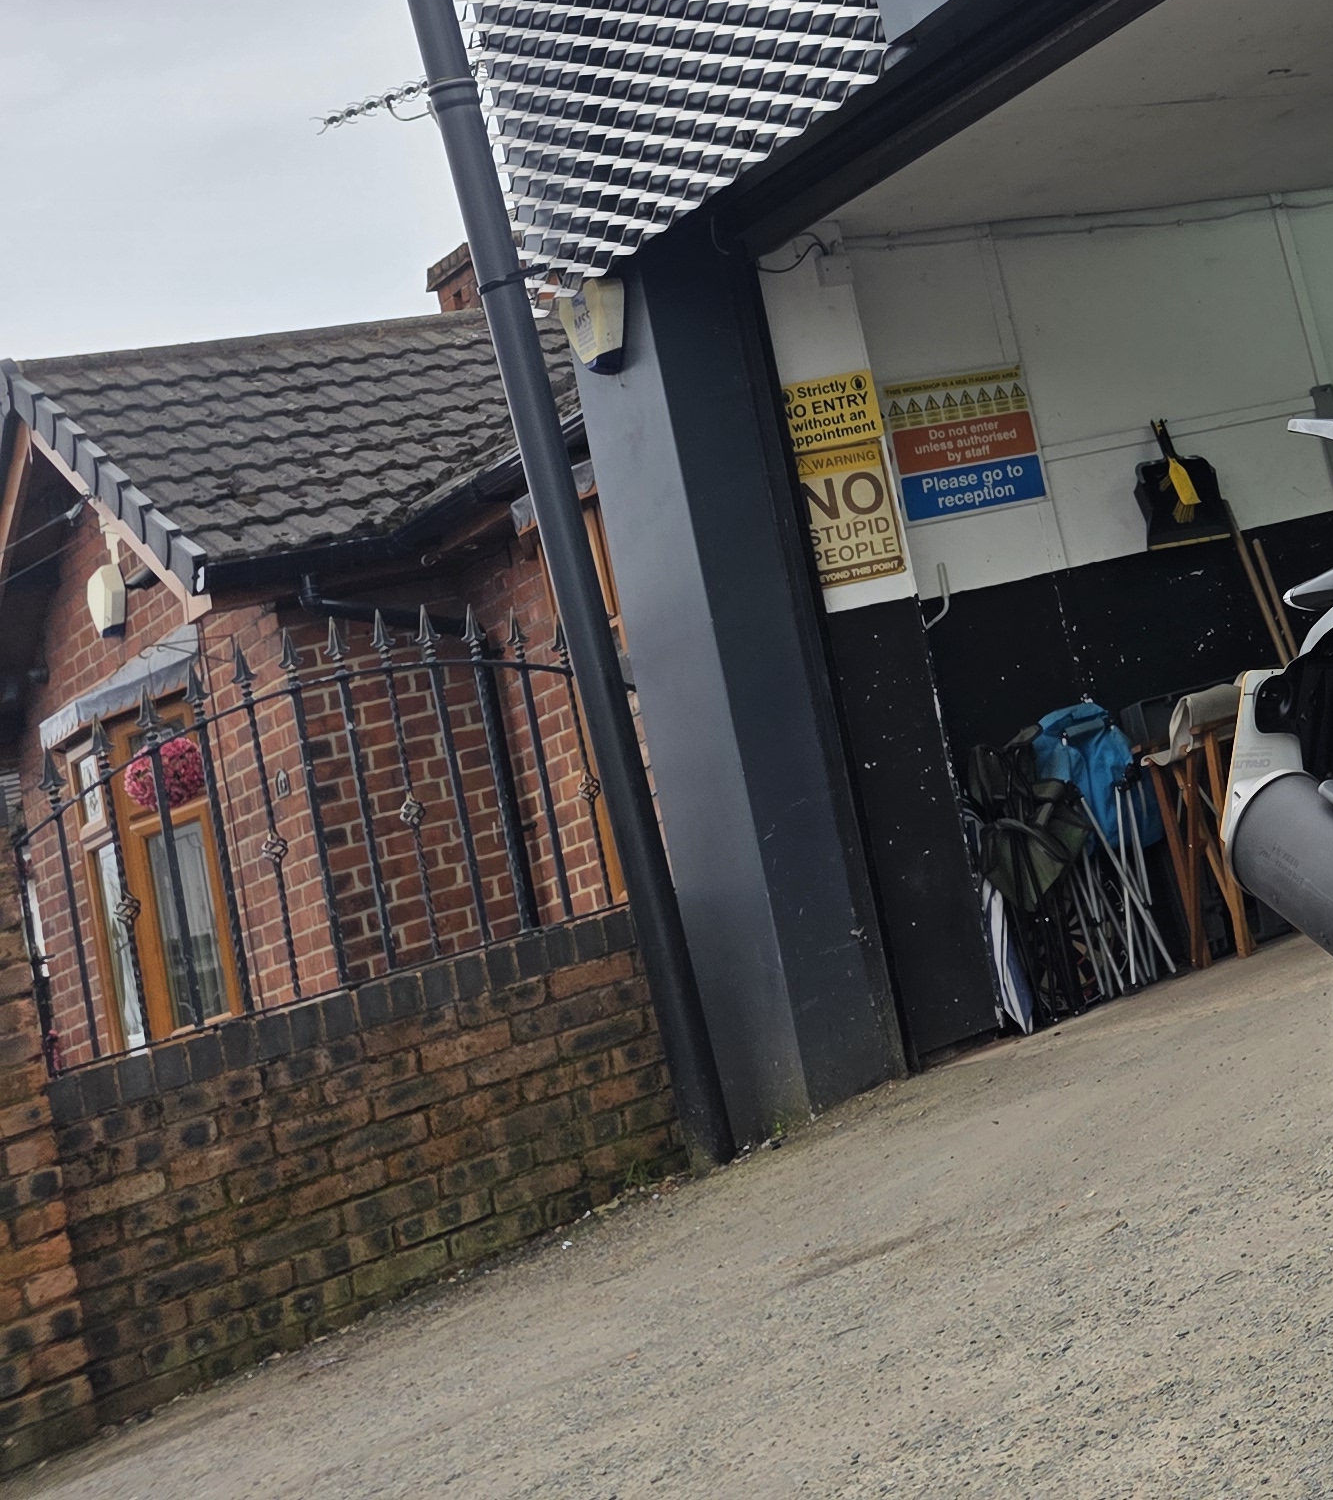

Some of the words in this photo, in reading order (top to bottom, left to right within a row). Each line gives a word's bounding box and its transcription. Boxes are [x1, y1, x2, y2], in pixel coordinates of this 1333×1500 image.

[796, 380, 847, 399] Strictly
[885, 387, 901, 396] THIS
[902, 382, 941, 395] WORKSHOP
[785, 404, 807, 420] NO
[811, 391, 869, 415] ENTRY
[792, 412, 846, 433] without
[849, 409, 867, 421] an
[928, 429, 946, 440] Do
[948, 426, 968, 437] not
[969, 420, 999, 433] enter
[914, 438, 954, 455] unless
[956, 428, 1017, 448] authorised
[946, 450, 962, 462] by
[964, 444, 991, 459] staff
[811, 449, 876, 471] WARNING
[921, 470, 978, 494] Please
[981, 468, 1003, 486] go
[1006, 464, 1024, 478] to
[800, 471, 884, 525] NO
[937, 483, 1016, 509] reception
[810, 516, 890, 548] STUPID
[820, 569, 850, 583] EYOND
[850, 565, 872, 577] THIS
[872, 560, 899, 573] POINT
